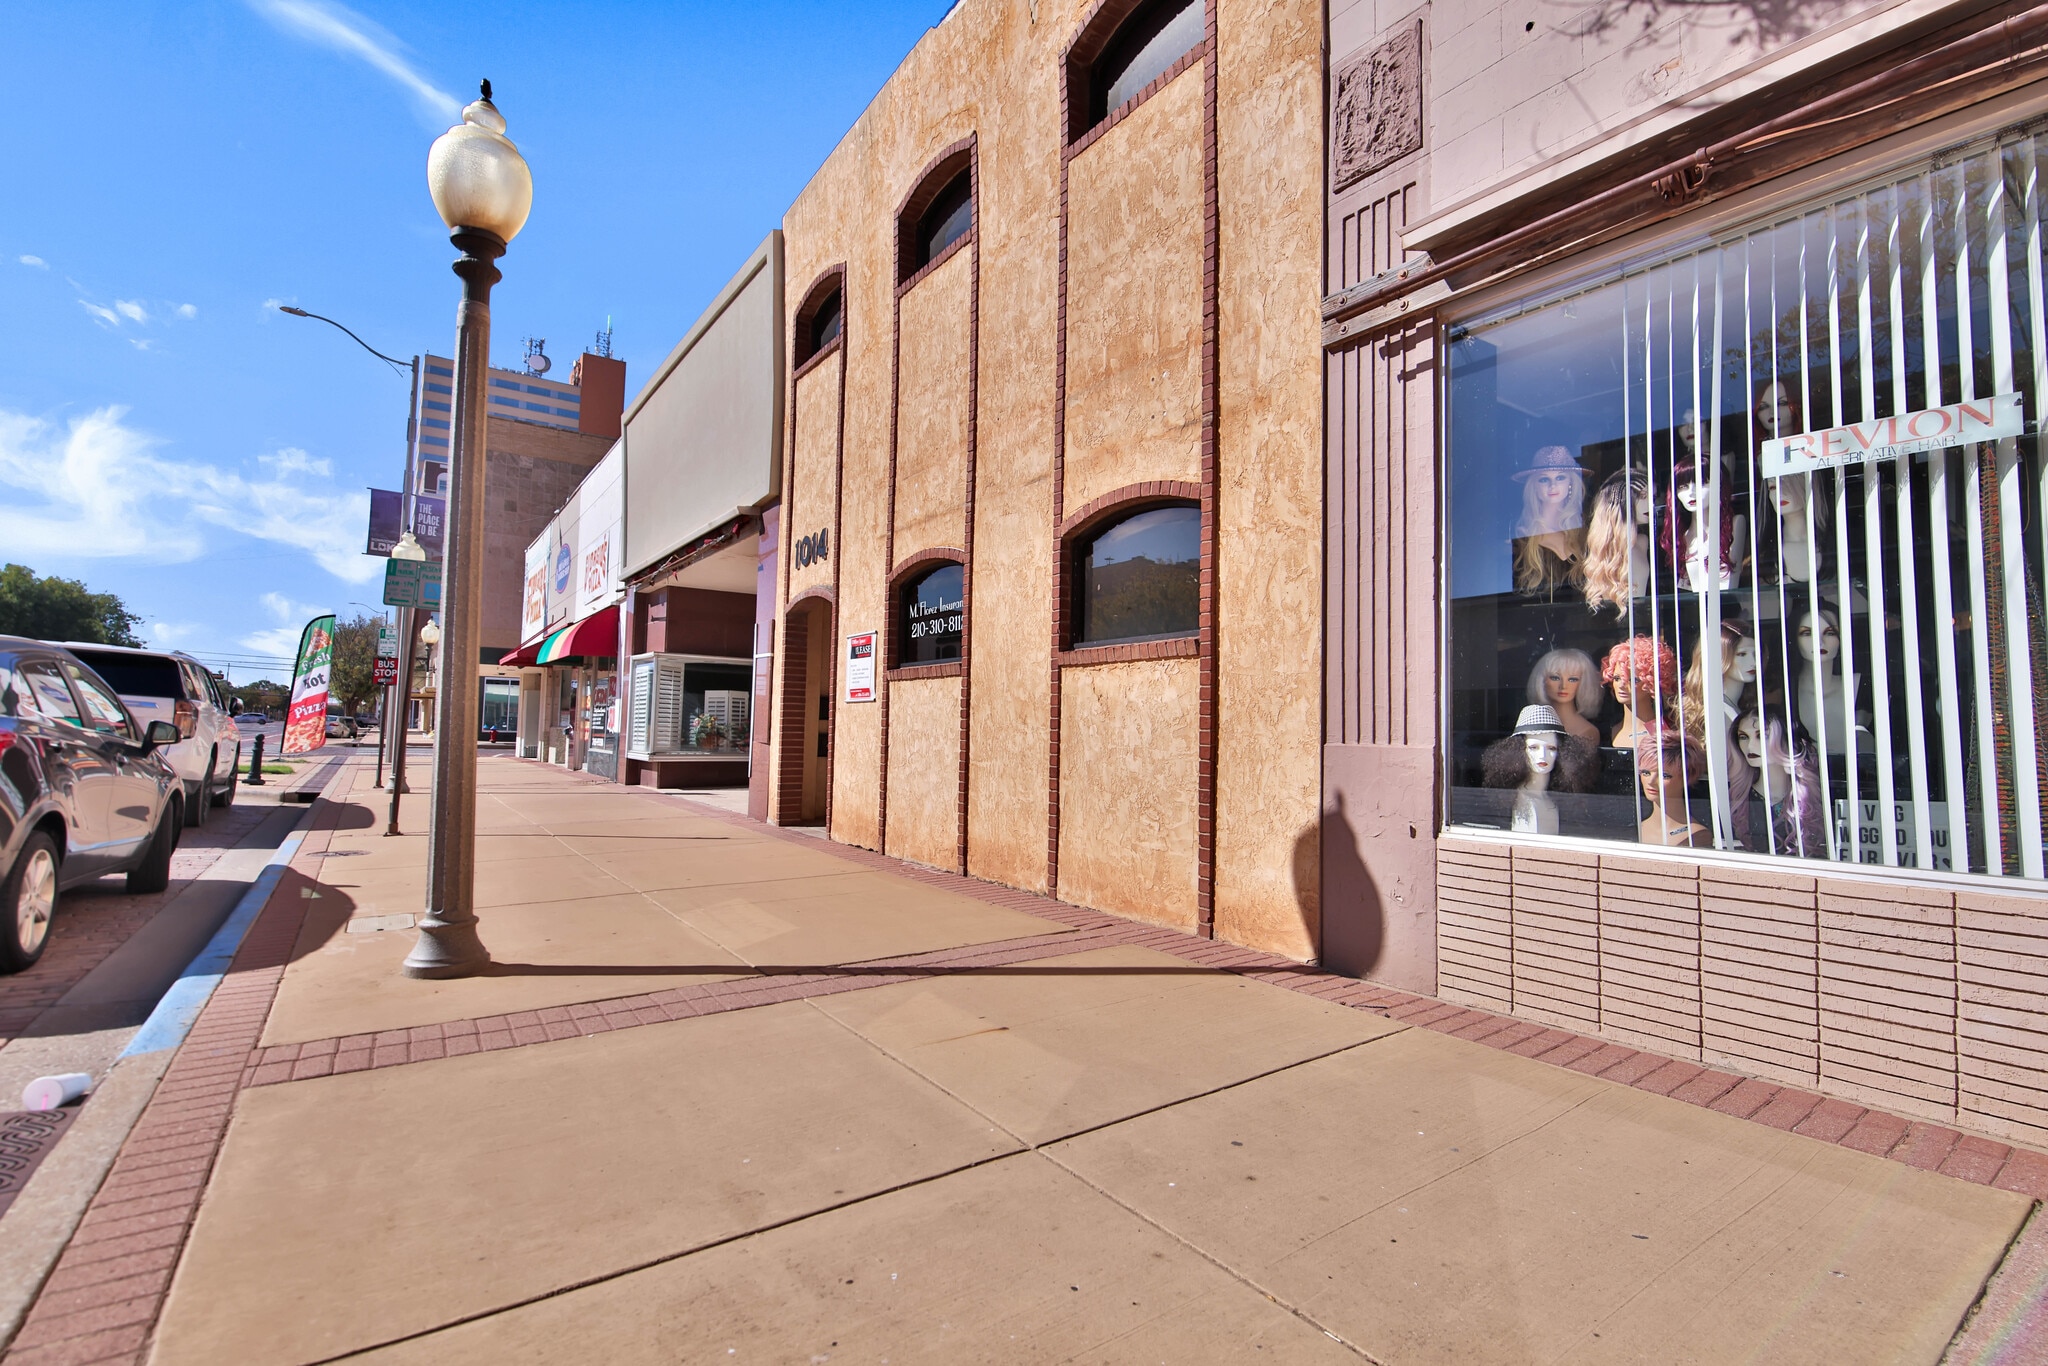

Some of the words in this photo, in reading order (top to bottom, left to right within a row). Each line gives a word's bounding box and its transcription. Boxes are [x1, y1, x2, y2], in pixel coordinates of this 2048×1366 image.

[1782, 397, 1996, 465] REVLON
[1918, 434, 1957, 452] HAIR
[419, 503, 432, 515] THE
[418, 513, 440, 526] PLACE
[417, 523, 427, 535] TO
[427, 525, 437, 537] BE
[795, 527, 829, 571] 1014
[909, 603, 919, 619] M.
[919, 600, 938, 617] Florez
[911, 614, 964, 638] 210-310-811
[301, 652, 331, 672] Fresh
[377, 660, 395, 668] BUS
[374, 668, 397, 677] STOP
[294, 701, 327, 719] Pizza
